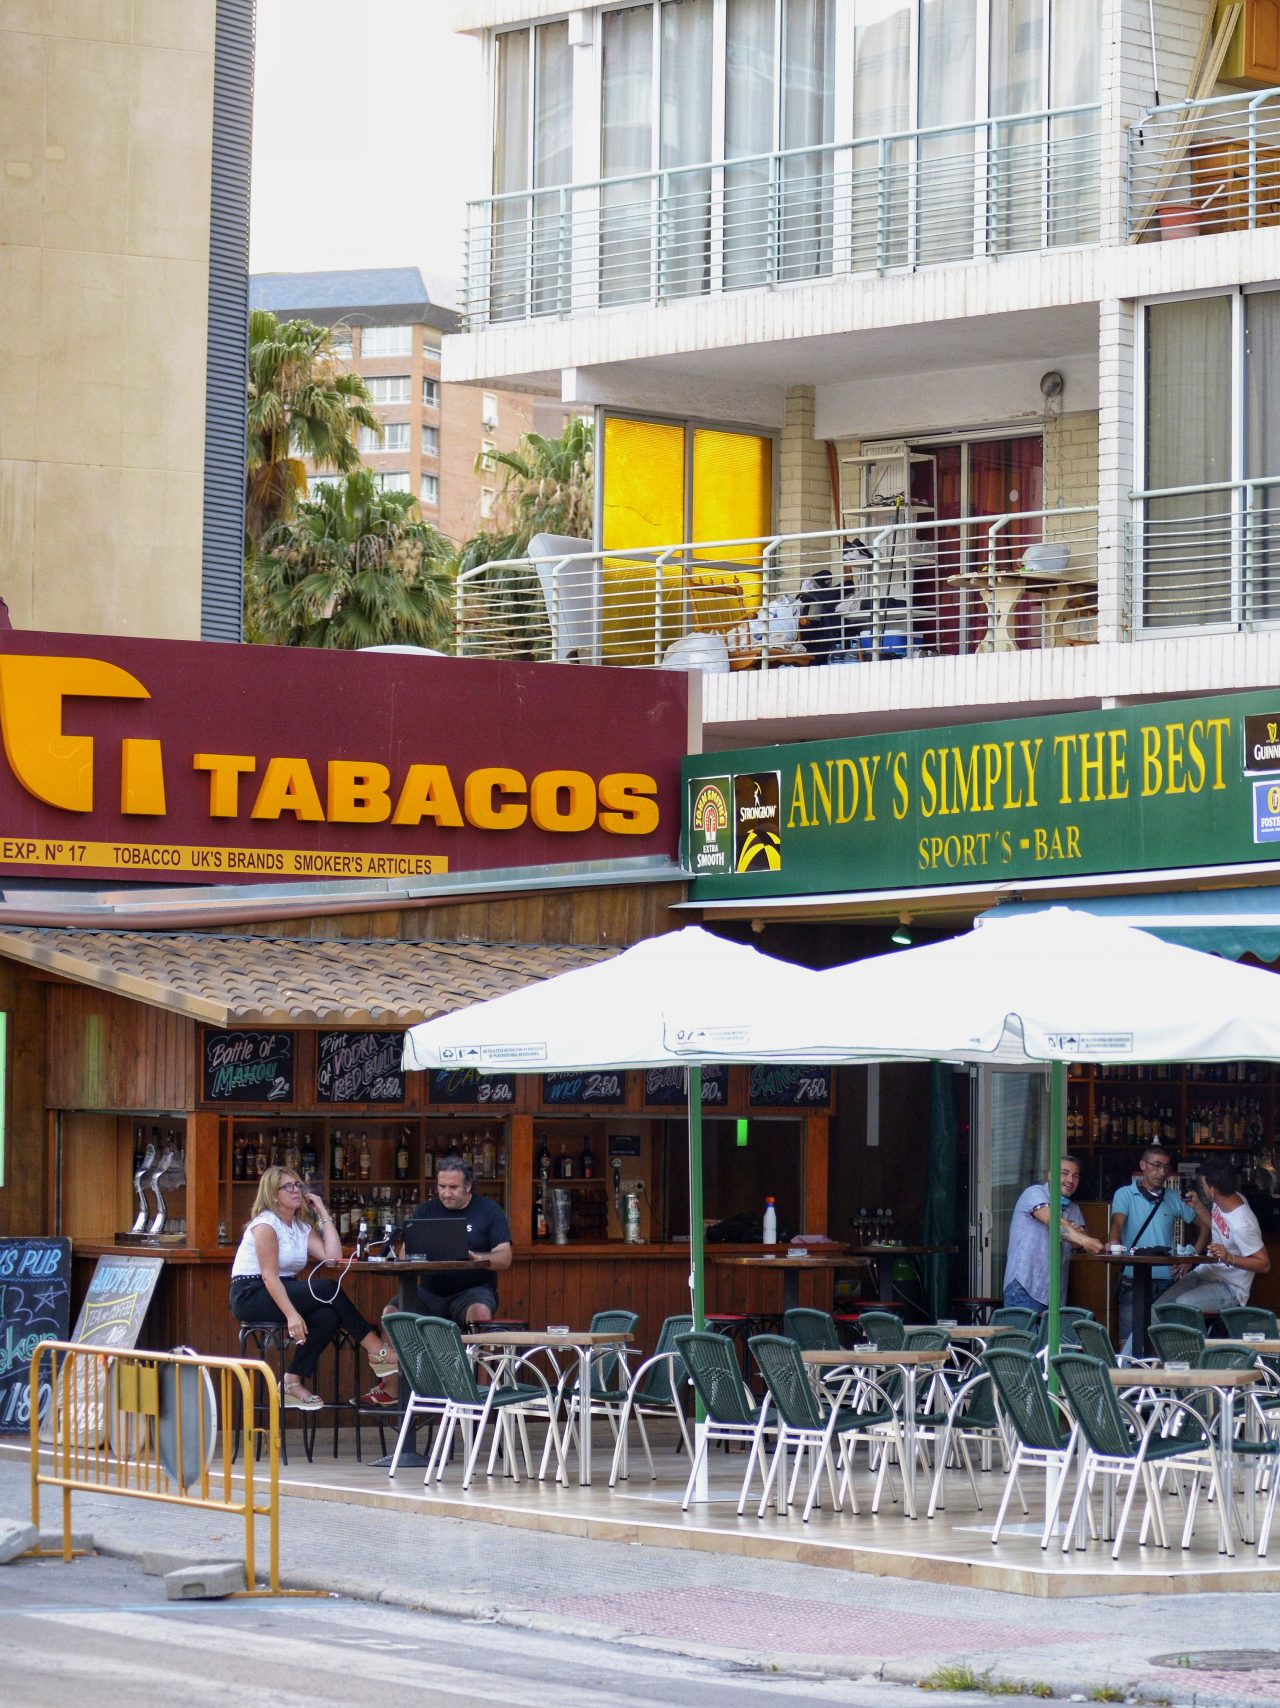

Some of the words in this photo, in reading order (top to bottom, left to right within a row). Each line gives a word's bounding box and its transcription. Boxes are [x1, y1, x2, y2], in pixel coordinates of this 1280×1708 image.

[787, 751, 909, 828] ANDY'S
[920, 738, 1043, 818] SIMPLY
[1053, 728, 1130, 805] THE
[1141, 717, 1231, 797] BEST
[193, 752, 659, 835] TABACOS
[740, 805, 777, 822] STRONGBOW
[3, 841, 39, 860] EXP.
[69, 845, 87, 861] 17
[113, 847, 181, 866] TOBACCO
[191, 850, 222, 868] UK'S
[228, 852, 284, 870] BRANDS
[294, 854, 363, 873] SMOKER'S
[367, 857, 432, 875] ARTICLES
[697, 852, 724, 868] SMOOTH
[703, 844, 719, 853] EXTRA
[918, 831, 1012, 870] SPORT'S
[1034, 825, 1082, 861] BAR
[212, 1037, 252, 1067] Bottle
[259, 1034, 276, 1058] of
[321, 1033, 349, 1058] Pint
[334, 1034, 380, 1075] VODKA
[18, 1248, 62, 1277] PUB
